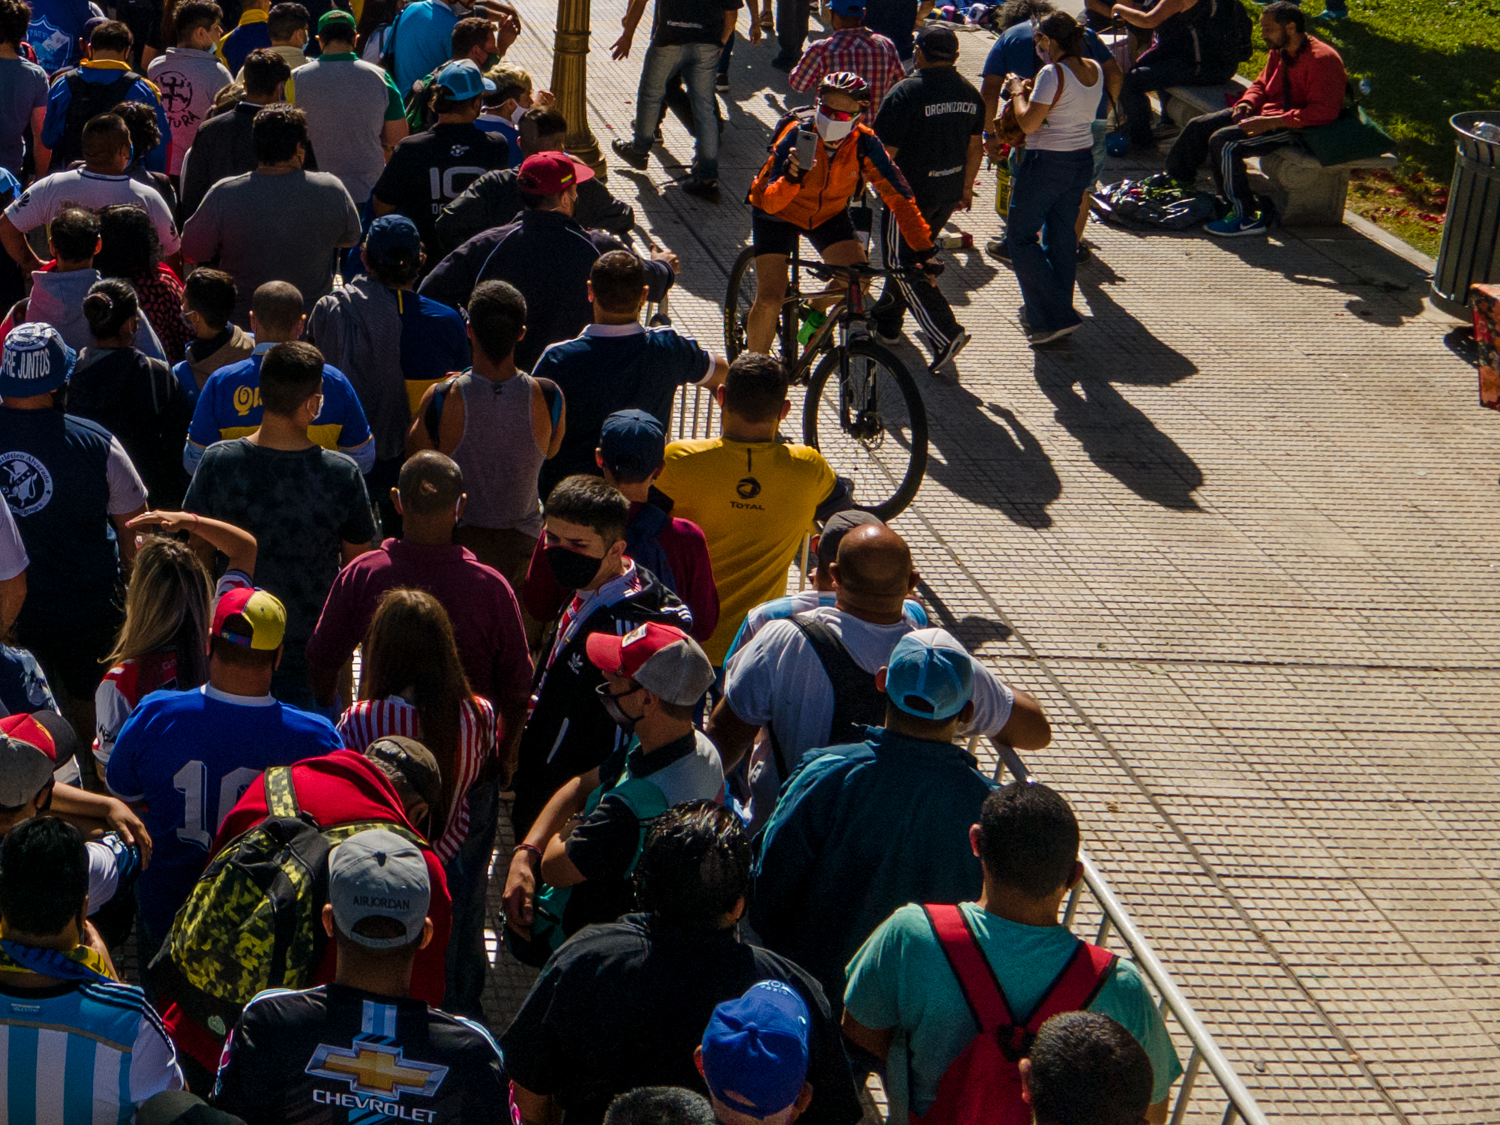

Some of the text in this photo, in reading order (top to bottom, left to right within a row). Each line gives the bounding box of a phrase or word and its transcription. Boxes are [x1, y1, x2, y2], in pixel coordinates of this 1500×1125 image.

[17, 347, 51, 380] JUNTOS
[729, 501, 766, 511] TOTAL
[353, 895, 411, 911] AIR JORDAN
[312, 1088, 438, 1124] CHEVROLET
